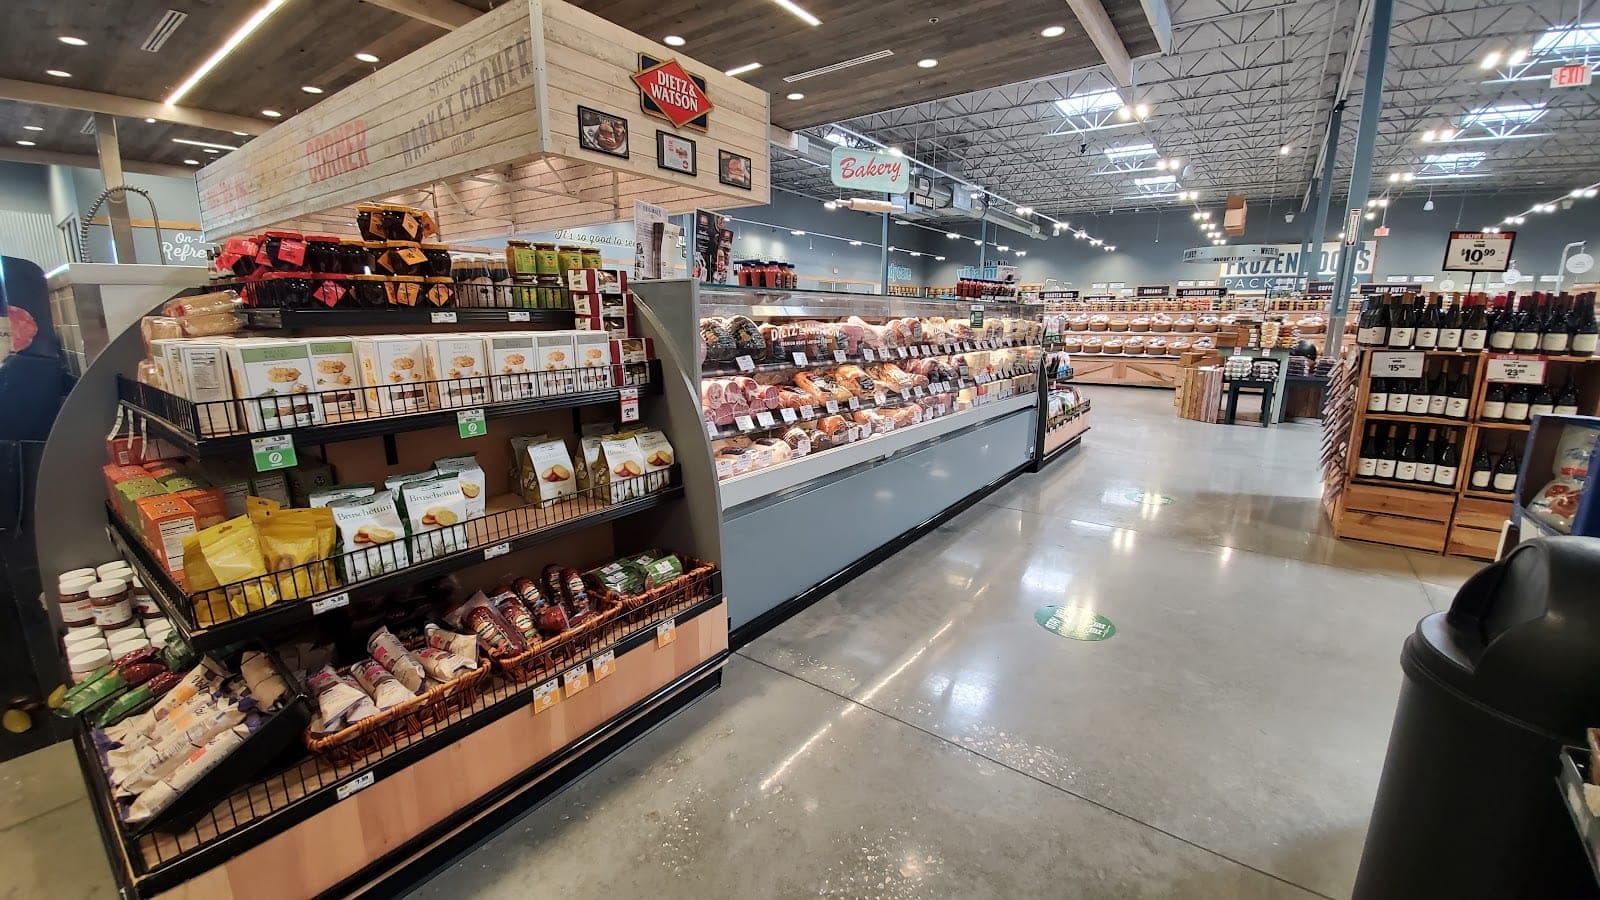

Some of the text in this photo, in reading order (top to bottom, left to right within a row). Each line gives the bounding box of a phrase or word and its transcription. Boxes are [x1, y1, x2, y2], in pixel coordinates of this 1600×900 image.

[459, 36, 534, 122] CORNER
[657, 70, 698, 99] DIETZ &
[1558, 67, 1586, 86] EXIT
[650, 83, 699, 113] WATSON
[306, 118, 370, 184] CORNER
[840, 156, 902, 182] Bakery
[576, 232, 587, 242] so
[589, 235, 612, 246] good
[408, 488, 460, 503] Bruschettini
[337, 504, 393, 521] Bruschettini
